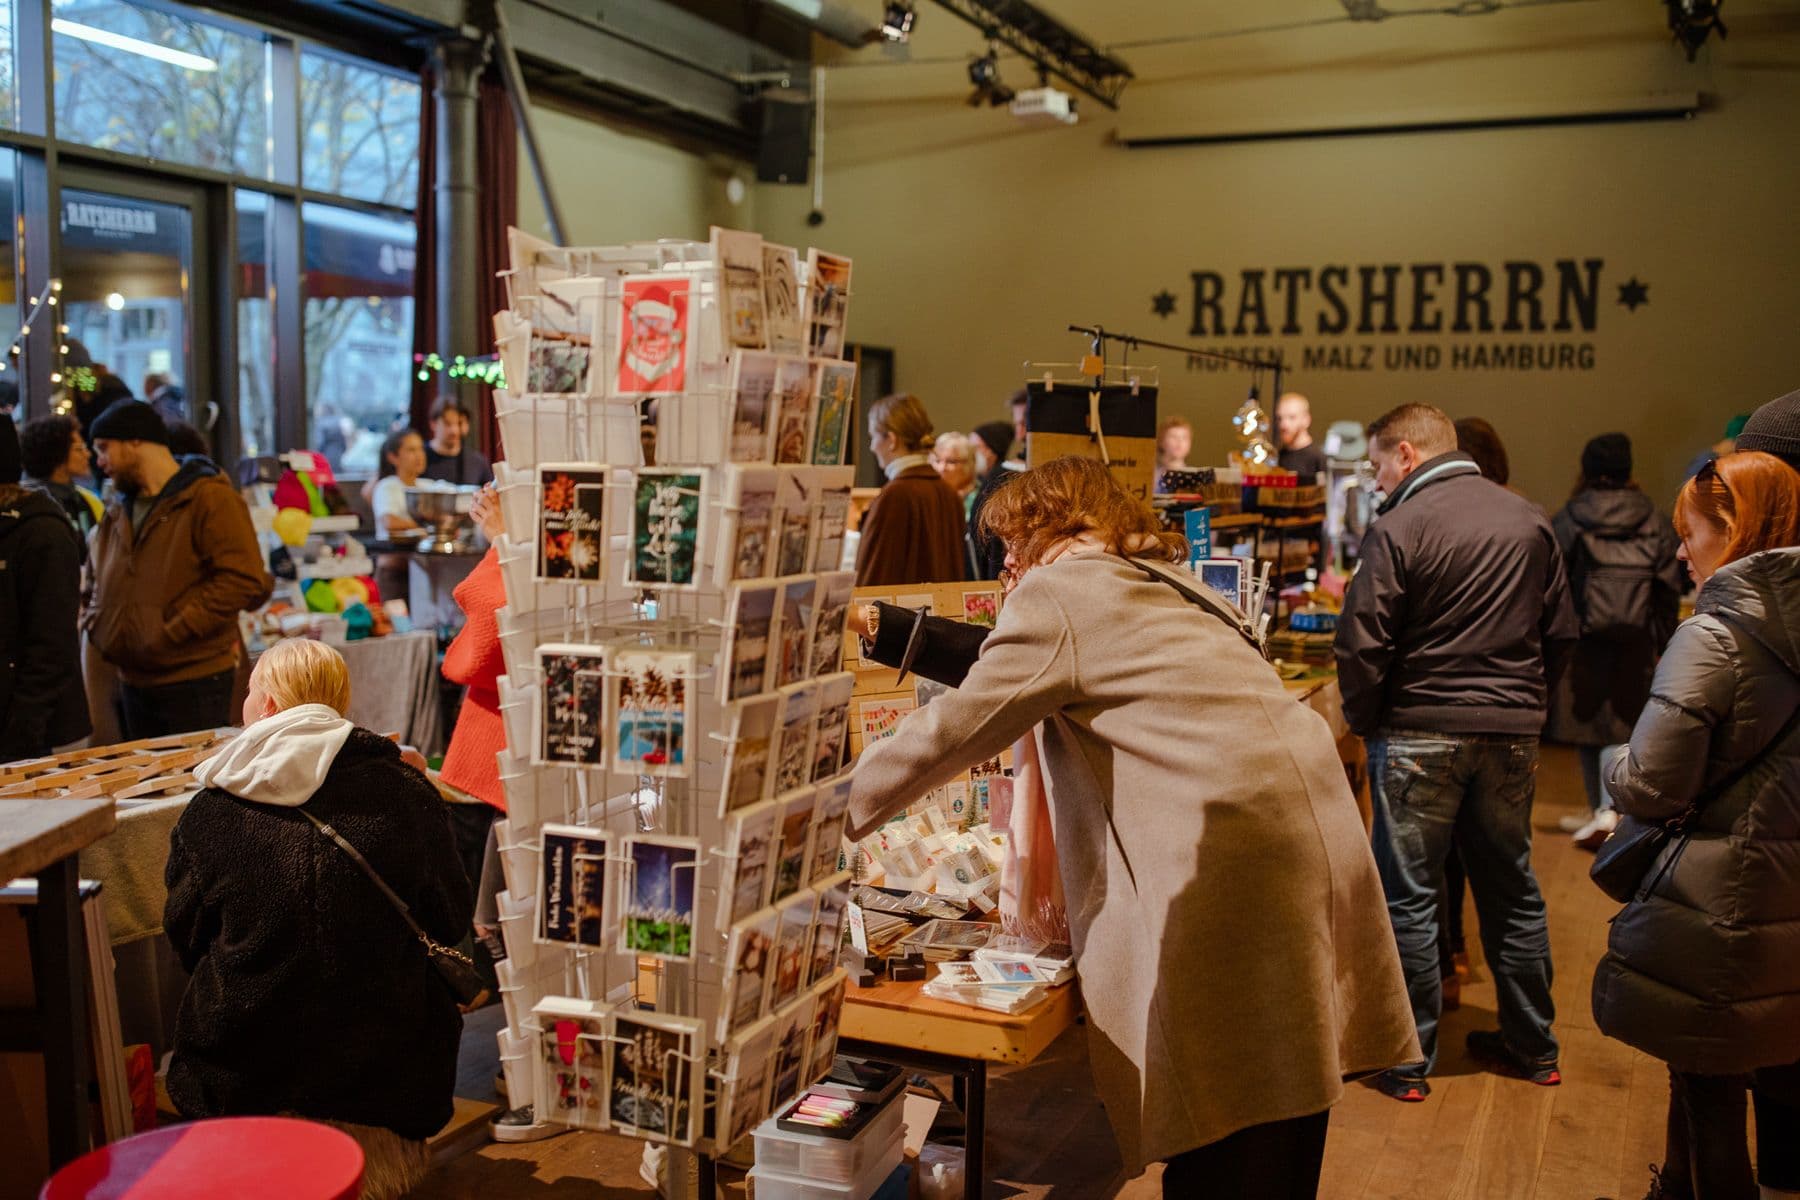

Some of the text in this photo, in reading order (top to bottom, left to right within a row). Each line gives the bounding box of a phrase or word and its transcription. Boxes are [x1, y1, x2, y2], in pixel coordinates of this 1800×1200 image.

[1188, 258, 1604, 337] RATSHERRN
[1303, 345, 1375, 371] MALZ
[1383, 343, 1442, 371] UND
[1451, 342, 1596, 371] HAMBURG
